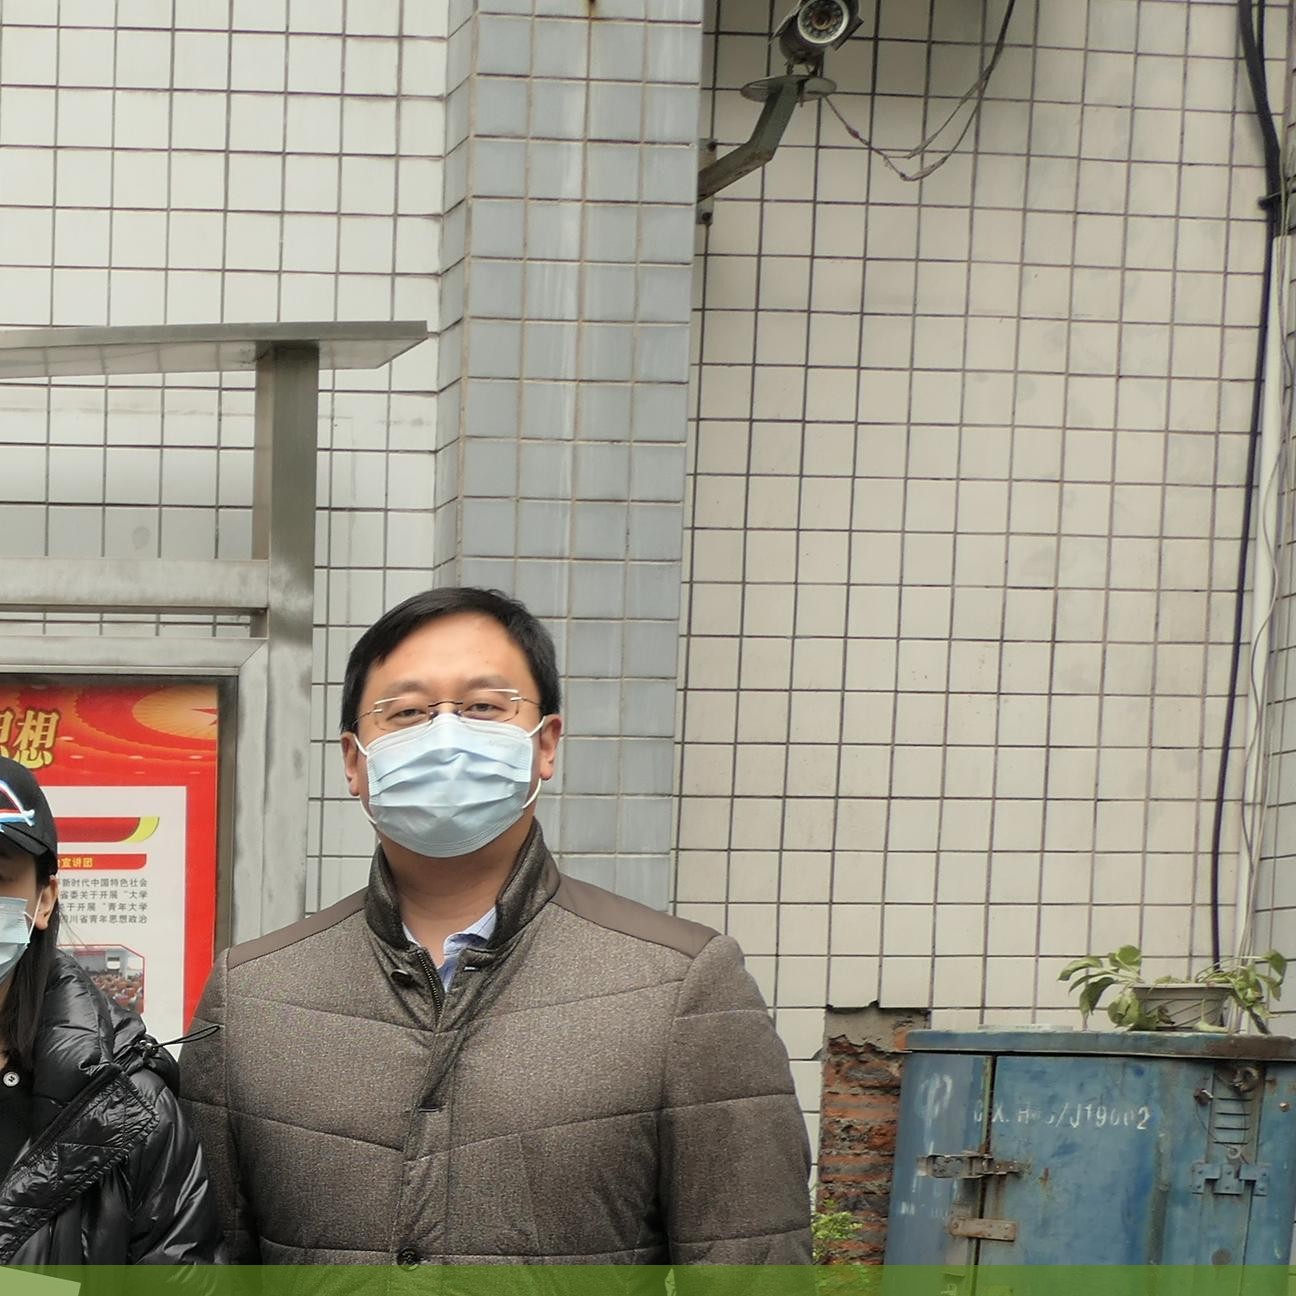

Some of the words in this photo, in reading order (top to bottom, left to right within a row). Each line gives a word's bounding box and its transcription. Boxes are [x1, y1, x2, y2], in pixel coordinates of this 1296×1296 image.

[58, 857, 93, 868] 宣讲团
[58, 878, 148, 888] 新时代中国特色社会
